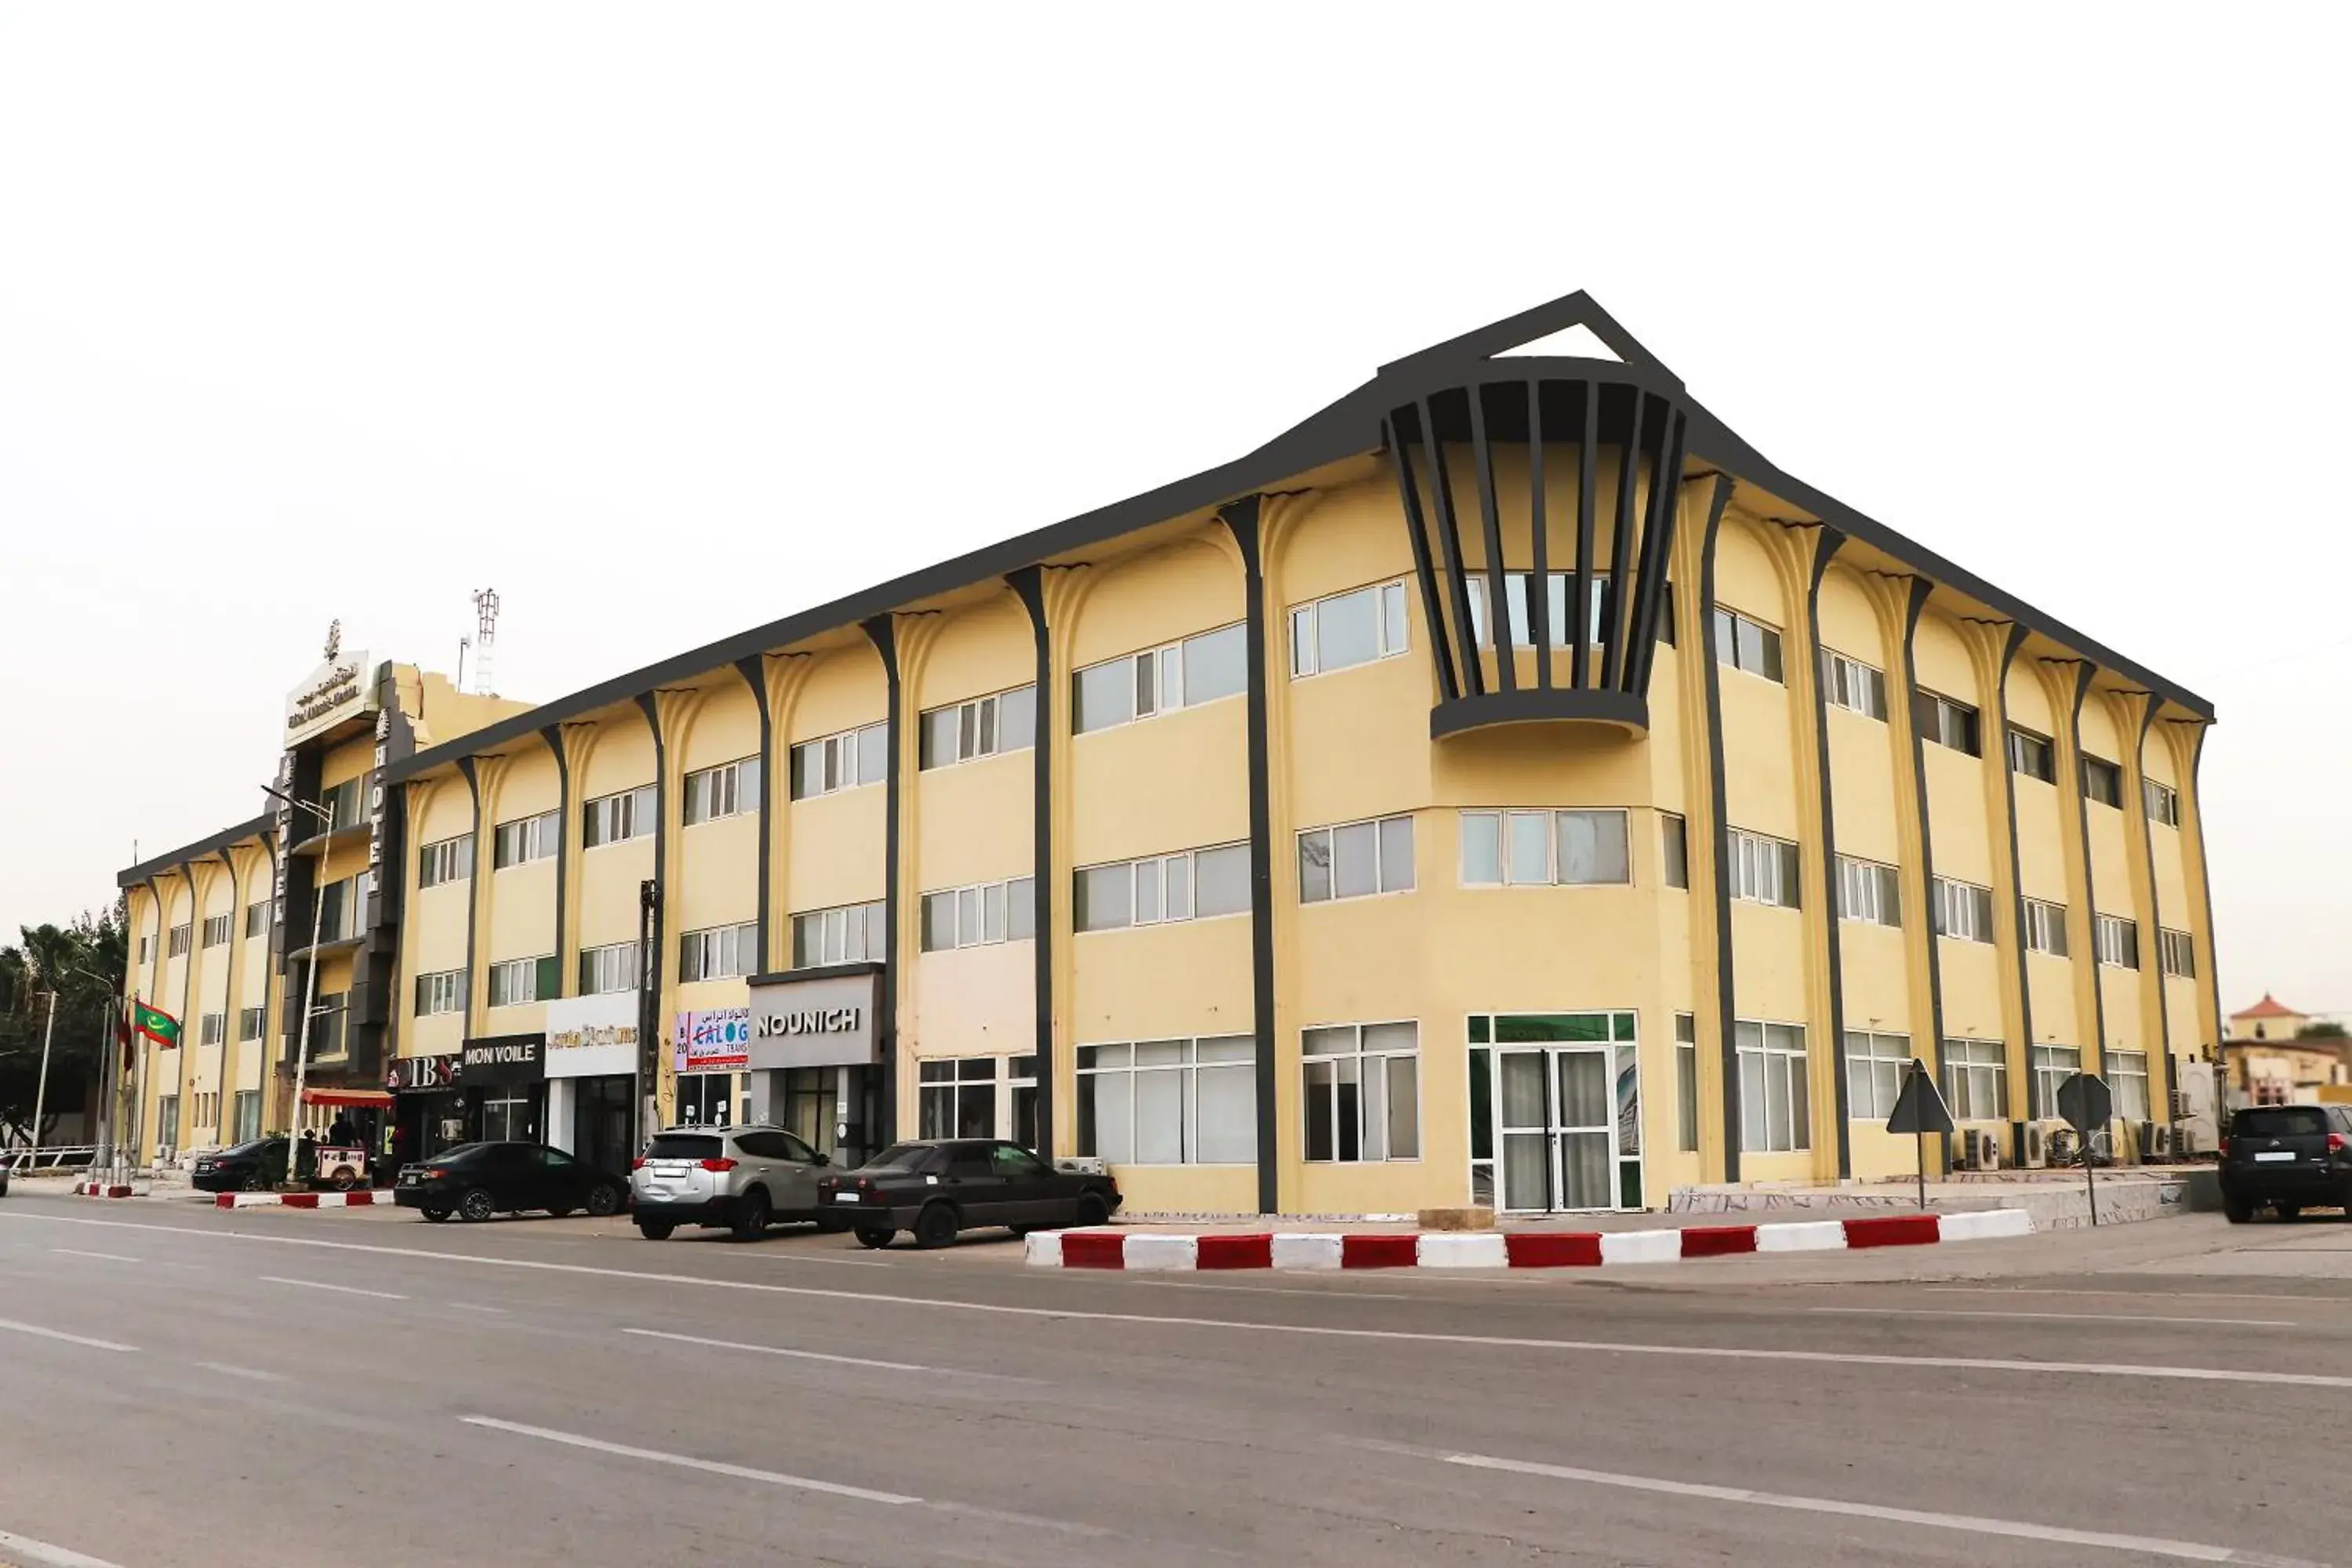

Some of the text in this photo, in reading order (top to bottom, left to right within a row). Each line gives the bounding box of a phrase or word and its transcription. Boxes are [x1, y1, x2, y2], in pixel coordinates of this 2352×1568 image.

[756, 1007, 860, 1038] NOUNICH
[465, 1044, 535, 1065] MON VOILE
